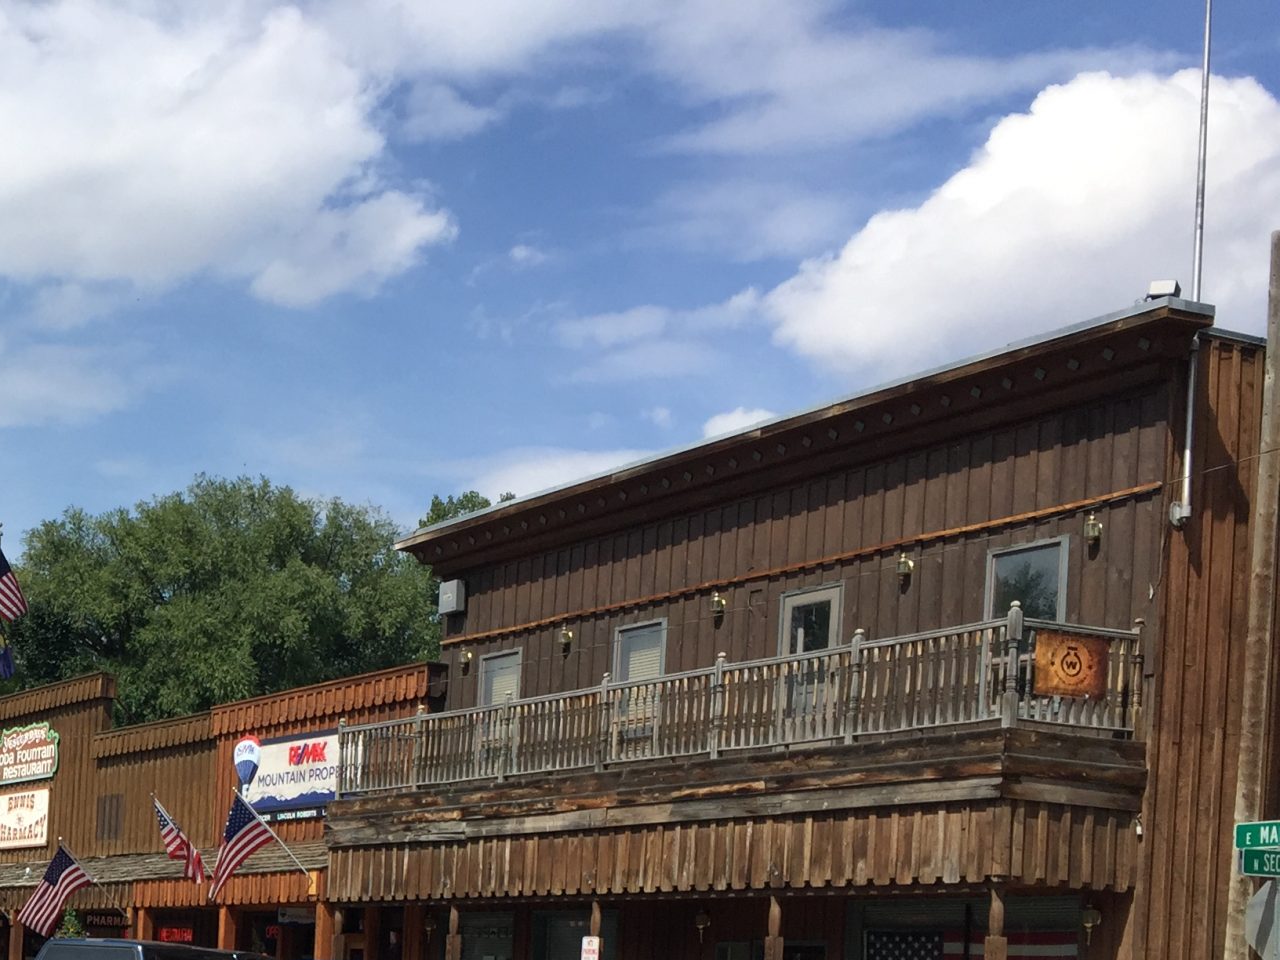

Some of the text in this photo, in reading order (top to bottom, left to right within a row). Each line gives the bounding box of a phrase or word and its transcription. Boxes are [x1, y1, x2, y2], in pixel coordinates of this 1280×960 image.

[17, 744, 54, 763] FOUNTAIN
[3, 759, 52, 779] RESTAURANT
[258, 769, 305, 787] MOUNTAIN
[8, 794, 35, 811] ENNIS
[1246, 825, 1280, 845] E MA
[86, 915, 127, 926] PHARMA
